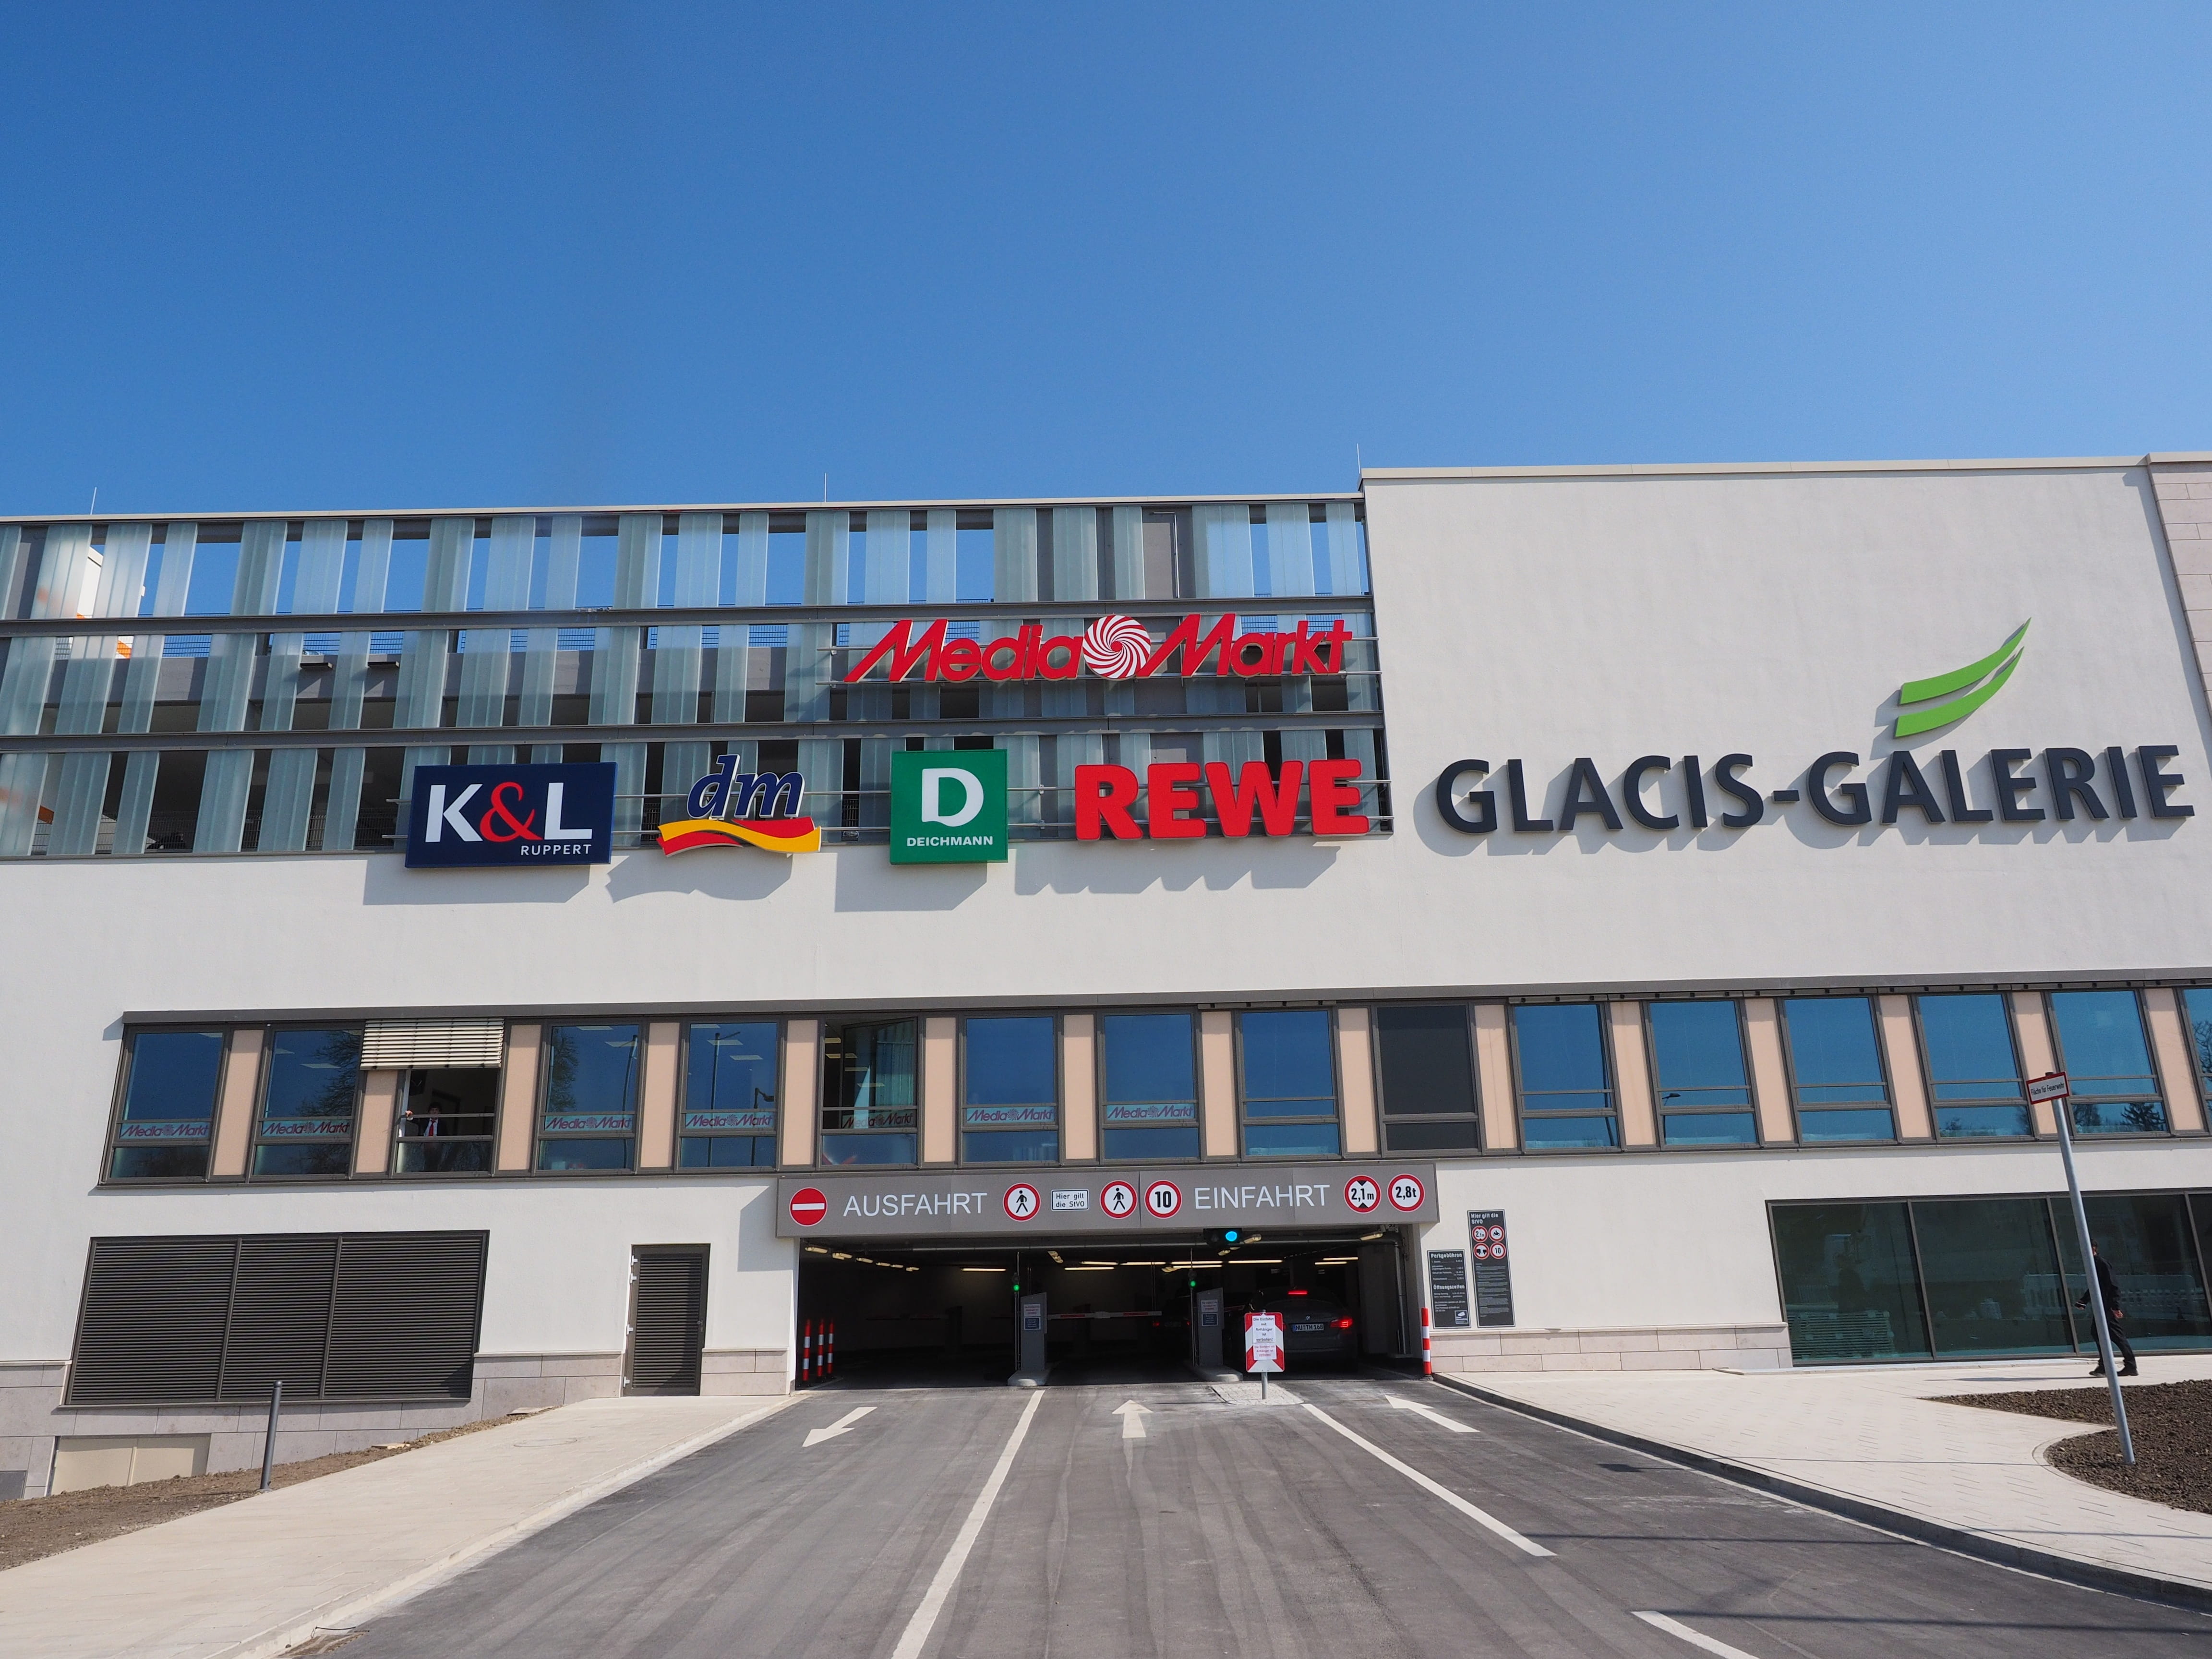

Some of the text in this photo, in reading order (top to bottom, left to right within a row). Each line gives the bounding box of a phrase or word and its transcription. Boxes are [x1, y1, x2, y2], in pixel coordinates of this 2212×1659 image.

[844, 613, 1353, 682] Media Markt
[686, 754, 805, 819] dm
[1435, 744, 2195, 835] GLACIS-GALERIE
[921, 767, 985, 827] D
[1074, 758, 1370, 841] REWE
[425, 781, 592, 843] K&L
[906, 835, 993, 847] DEICHMANN
[520, 843, 592, 856] RUPPERT
[967, 1108, 1053, 1121] Media Markt
[1107, 1105, 1193, 1118] Media Markt
[262, 1121, 350, 1134] Media Markt
[546, 1116, 632, 1129] Media Markt
[686, 1114, 772, 1127] Media Markt
[120, 1124, 208, 1136] Media Markt
[1154, 1191, 1171, 1208] 10
[1195, 1184, 1330, 1209] EINFAHRT
[1395, 1186, 1417, 1200] 2,8t
[843, 1193, 987, 1217] AUSFAHRT
